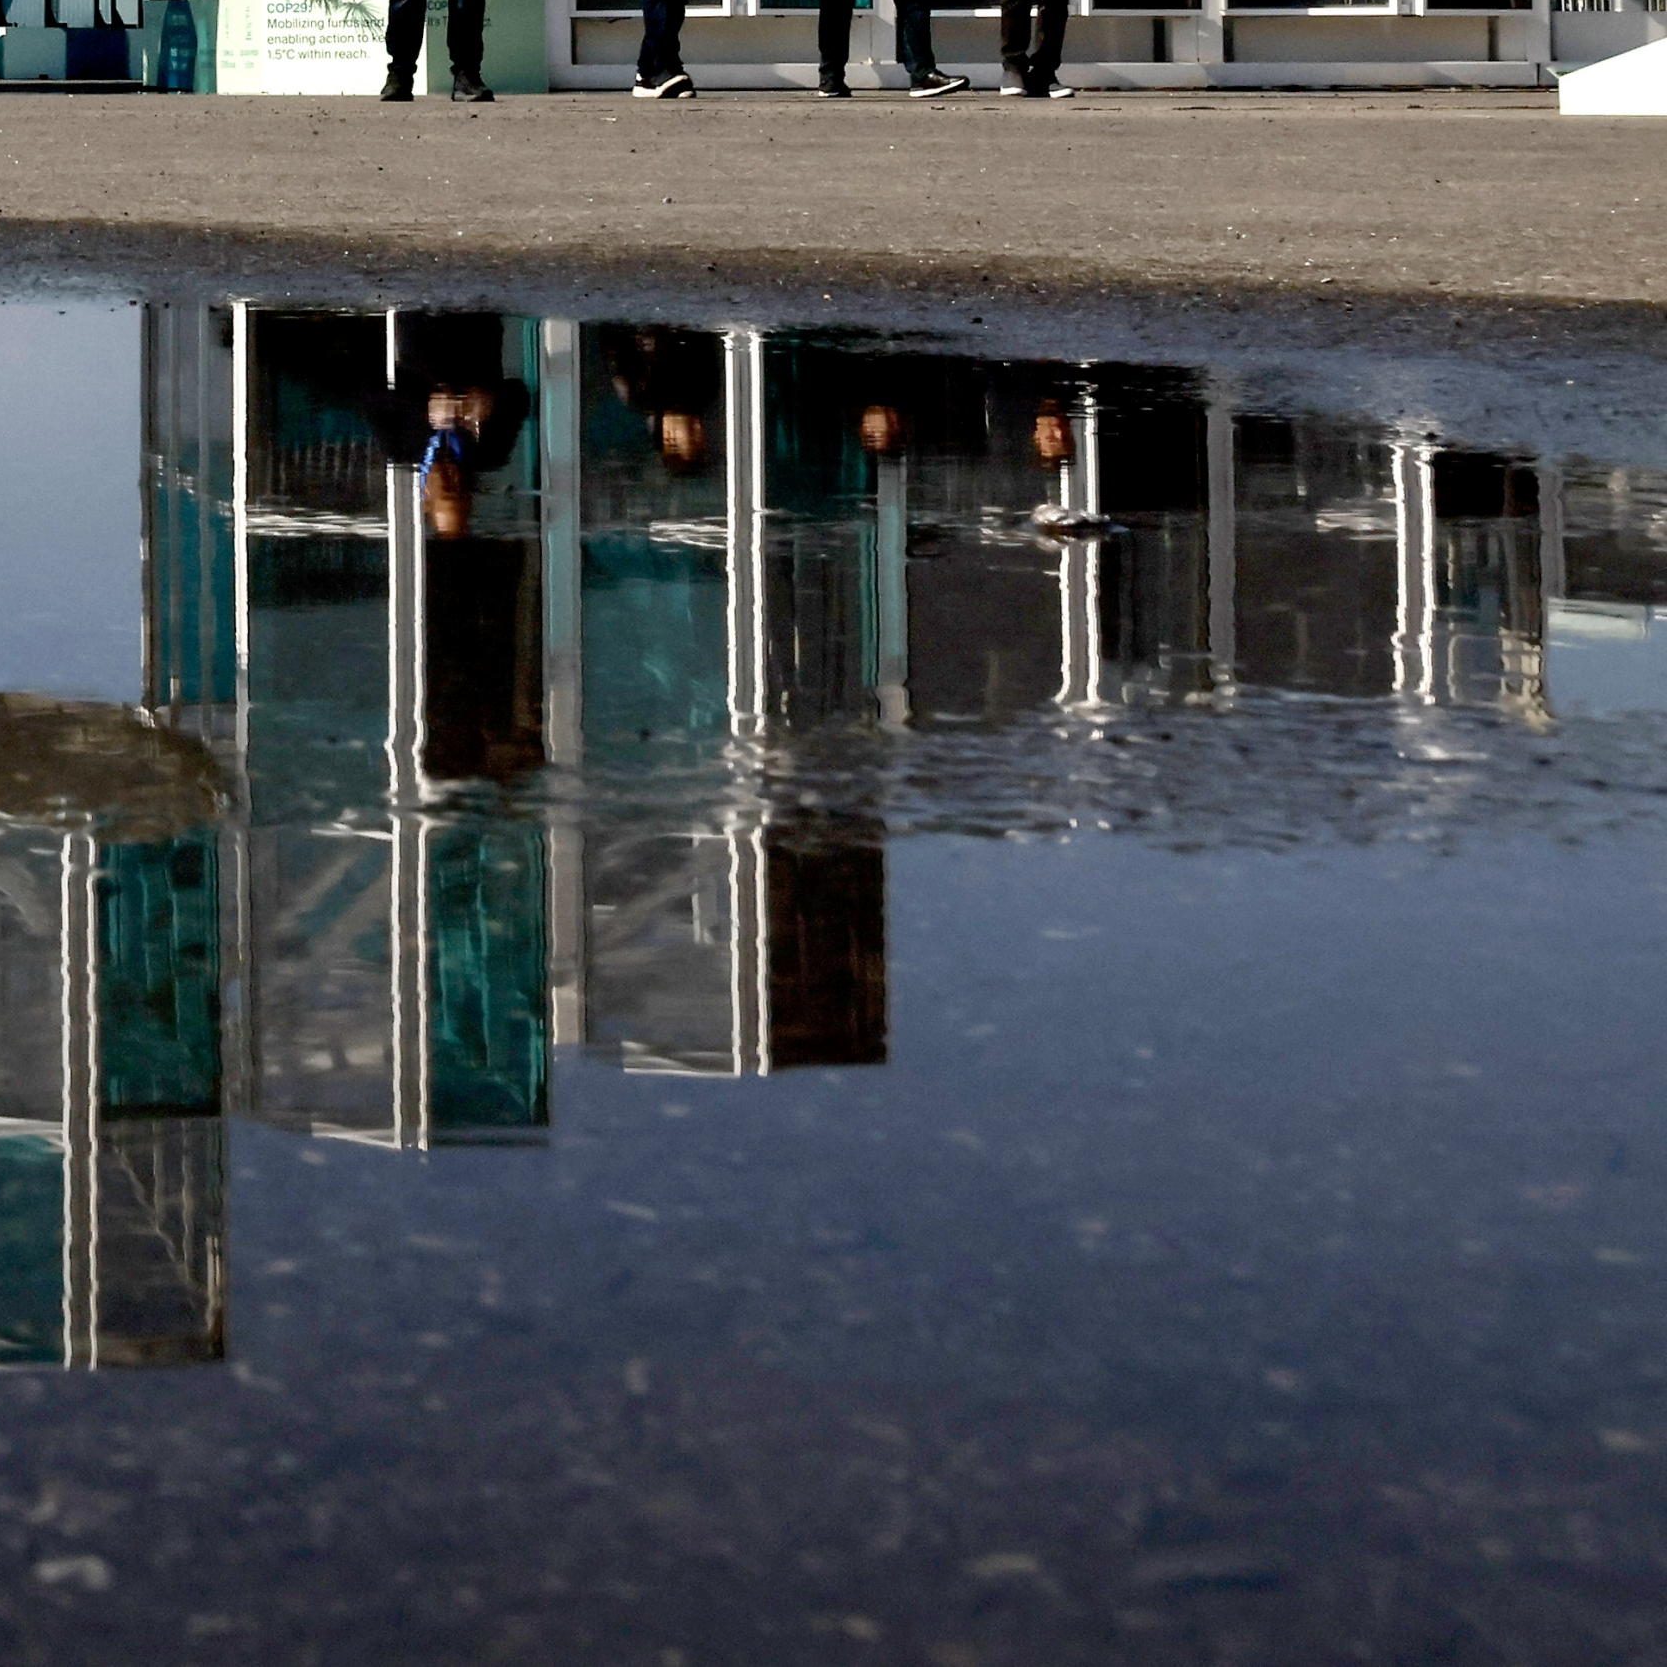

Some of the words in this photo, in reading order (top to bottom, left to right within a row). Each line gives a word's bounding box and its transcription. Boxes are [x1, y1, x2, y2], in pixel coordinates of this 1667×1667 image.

[267, 18, 325, 31] Mobilizing
[267, 34, 316, 46] enabling
[318, 34, 355, 45] action
[357, 34, 369, 44] to
[372, 34, 386, 44] ke
[298, 48, 332, 59] within
[334, 48, 371, 59] reach.
